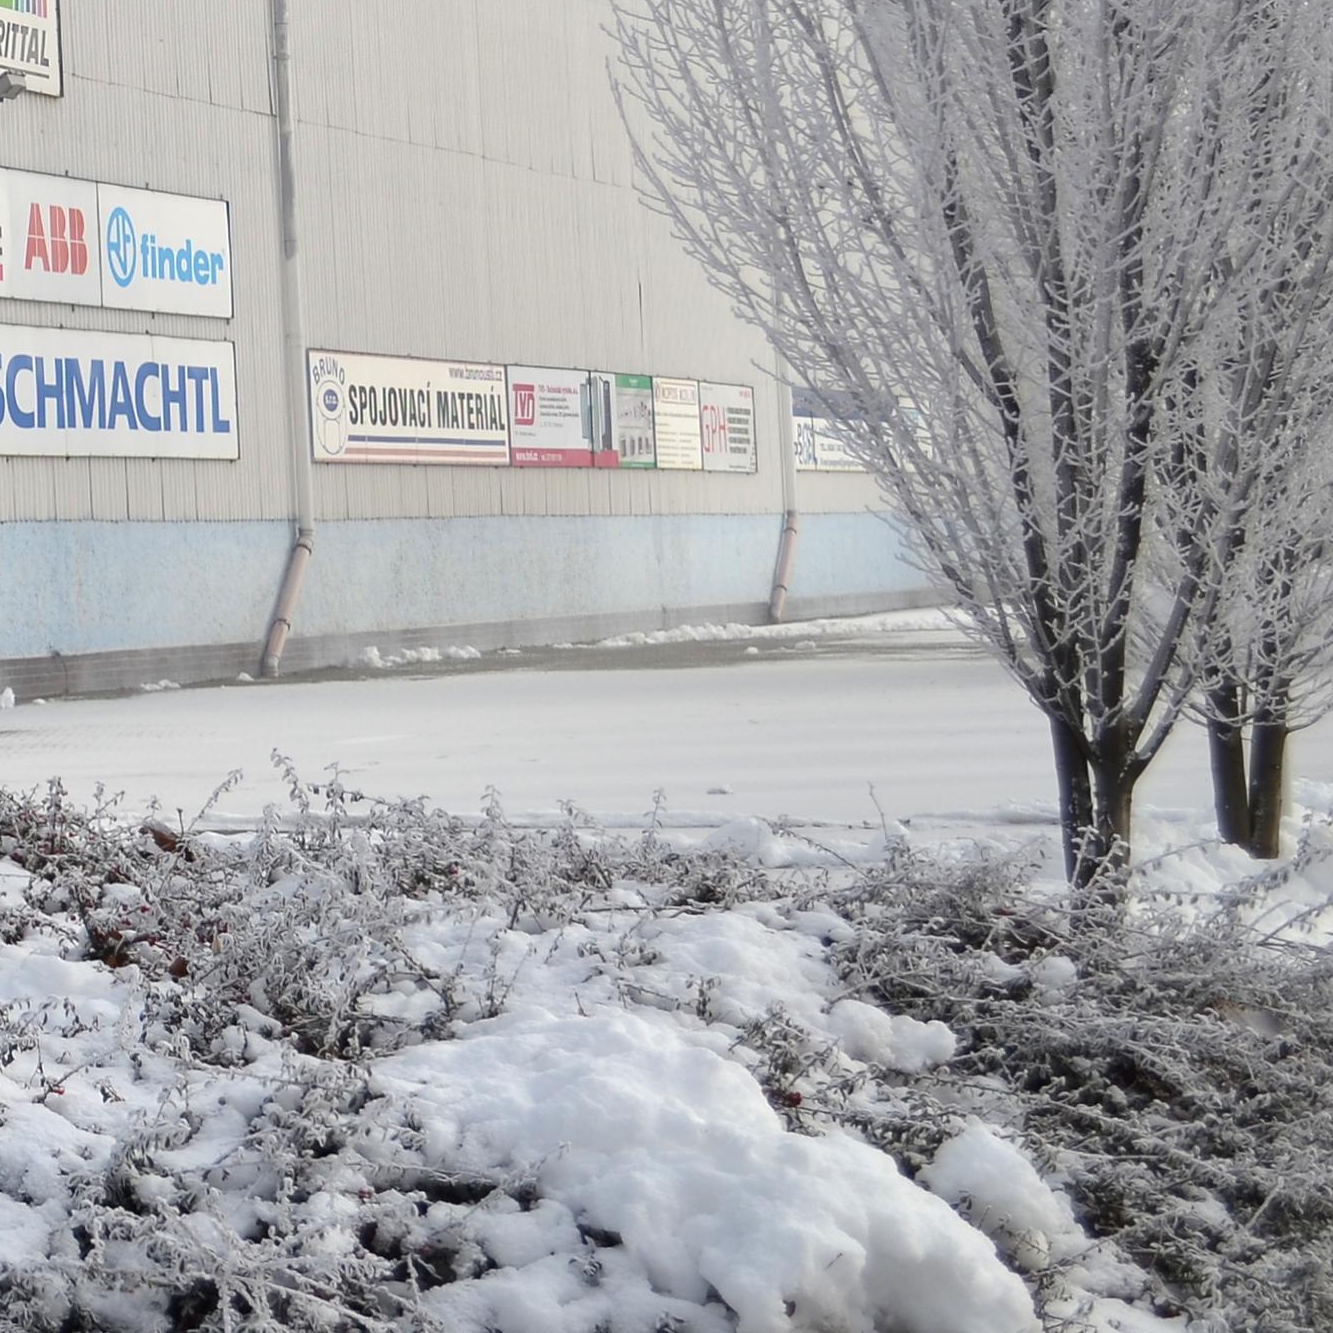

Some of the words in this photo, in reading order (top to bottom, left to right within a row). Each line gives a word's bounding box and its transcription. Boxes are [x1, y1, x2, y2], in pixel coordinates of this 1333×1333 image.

[25, 202, 88, 275] ABB
[140, 233, 224, 285] finder
[313, 357, 346, 385] BRUNO
[348, 381, 432, 428] SPOJOVACÍ
[437, 385, 505, 431] MATERIÁL
